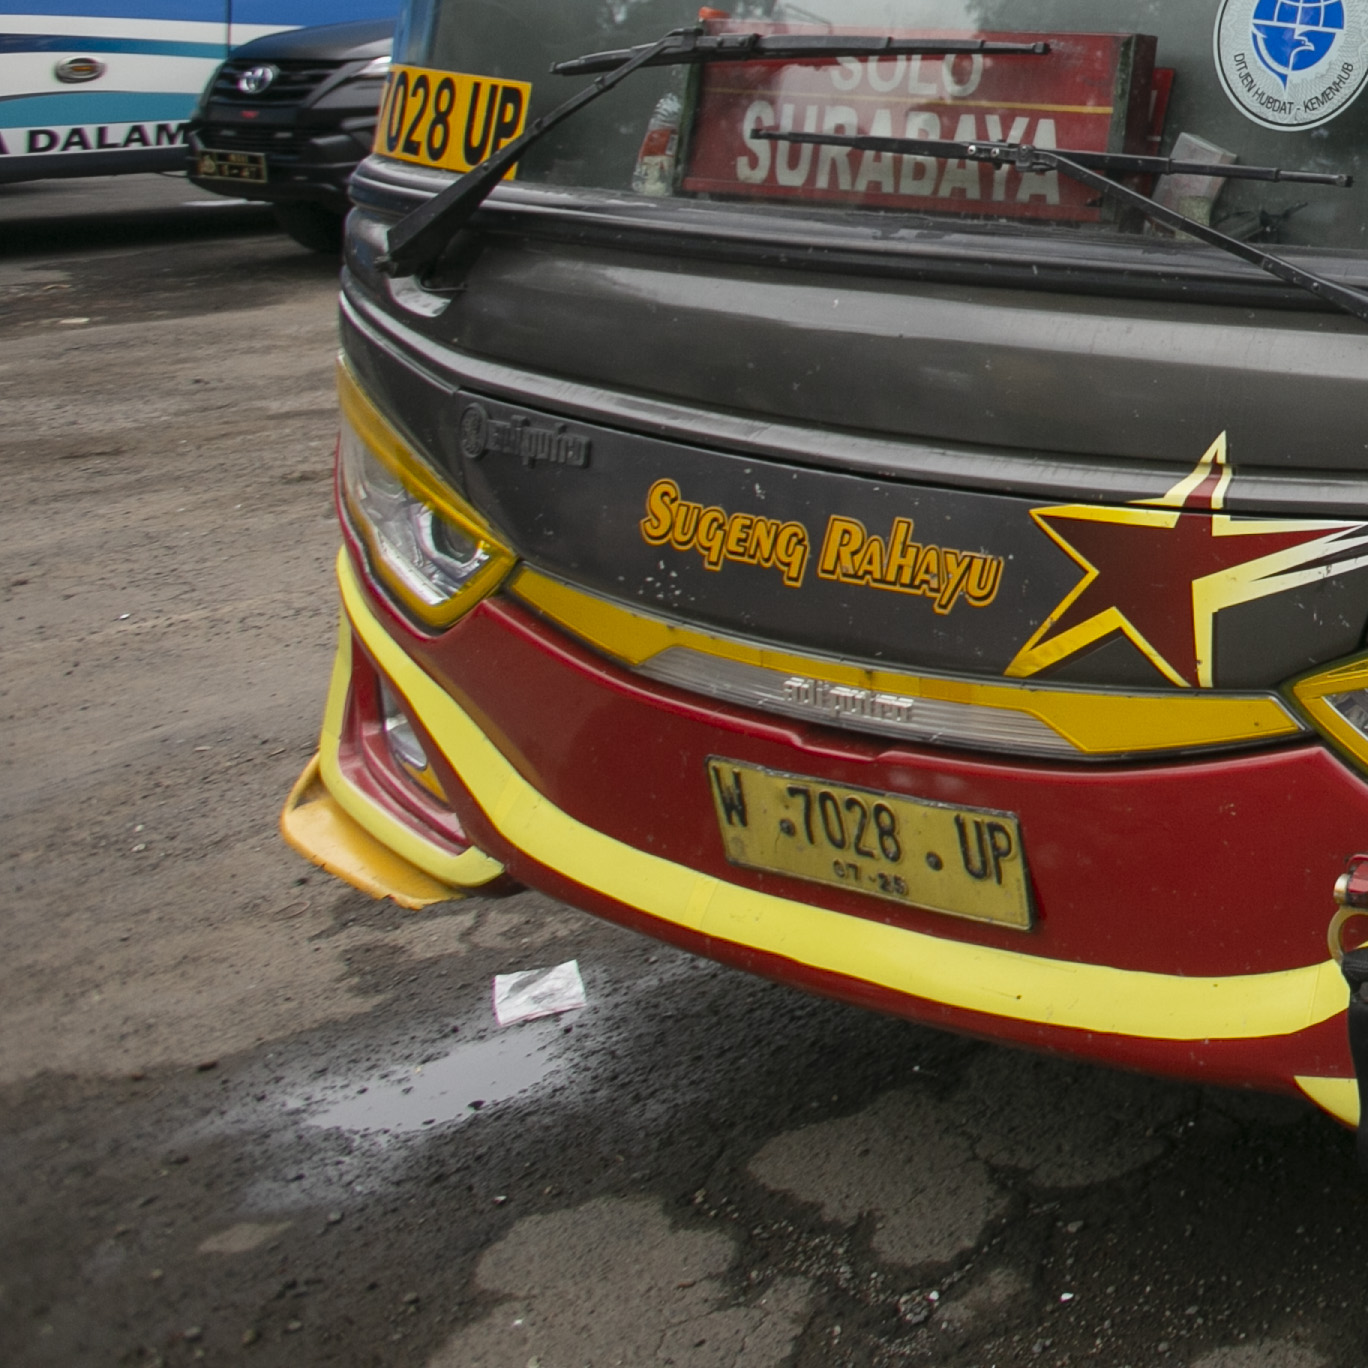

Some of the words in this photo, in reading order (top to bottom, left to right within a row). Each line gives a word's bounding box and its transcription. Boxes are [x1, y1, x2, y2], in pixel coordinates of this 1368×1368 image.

[1233, 52, 1255, 93] DITJEN
[1252, 87, 1294, 115] HUBDAT
[1303, 62, 1354, 114] KEMENHUB
[27, 122, 190, 153] DALAM
[464, 80, 523, 166] UP
[711, 764, 749, 829] W
[786, 783, 902, 864] 7028
[953, 812, 1013, 886] UP
